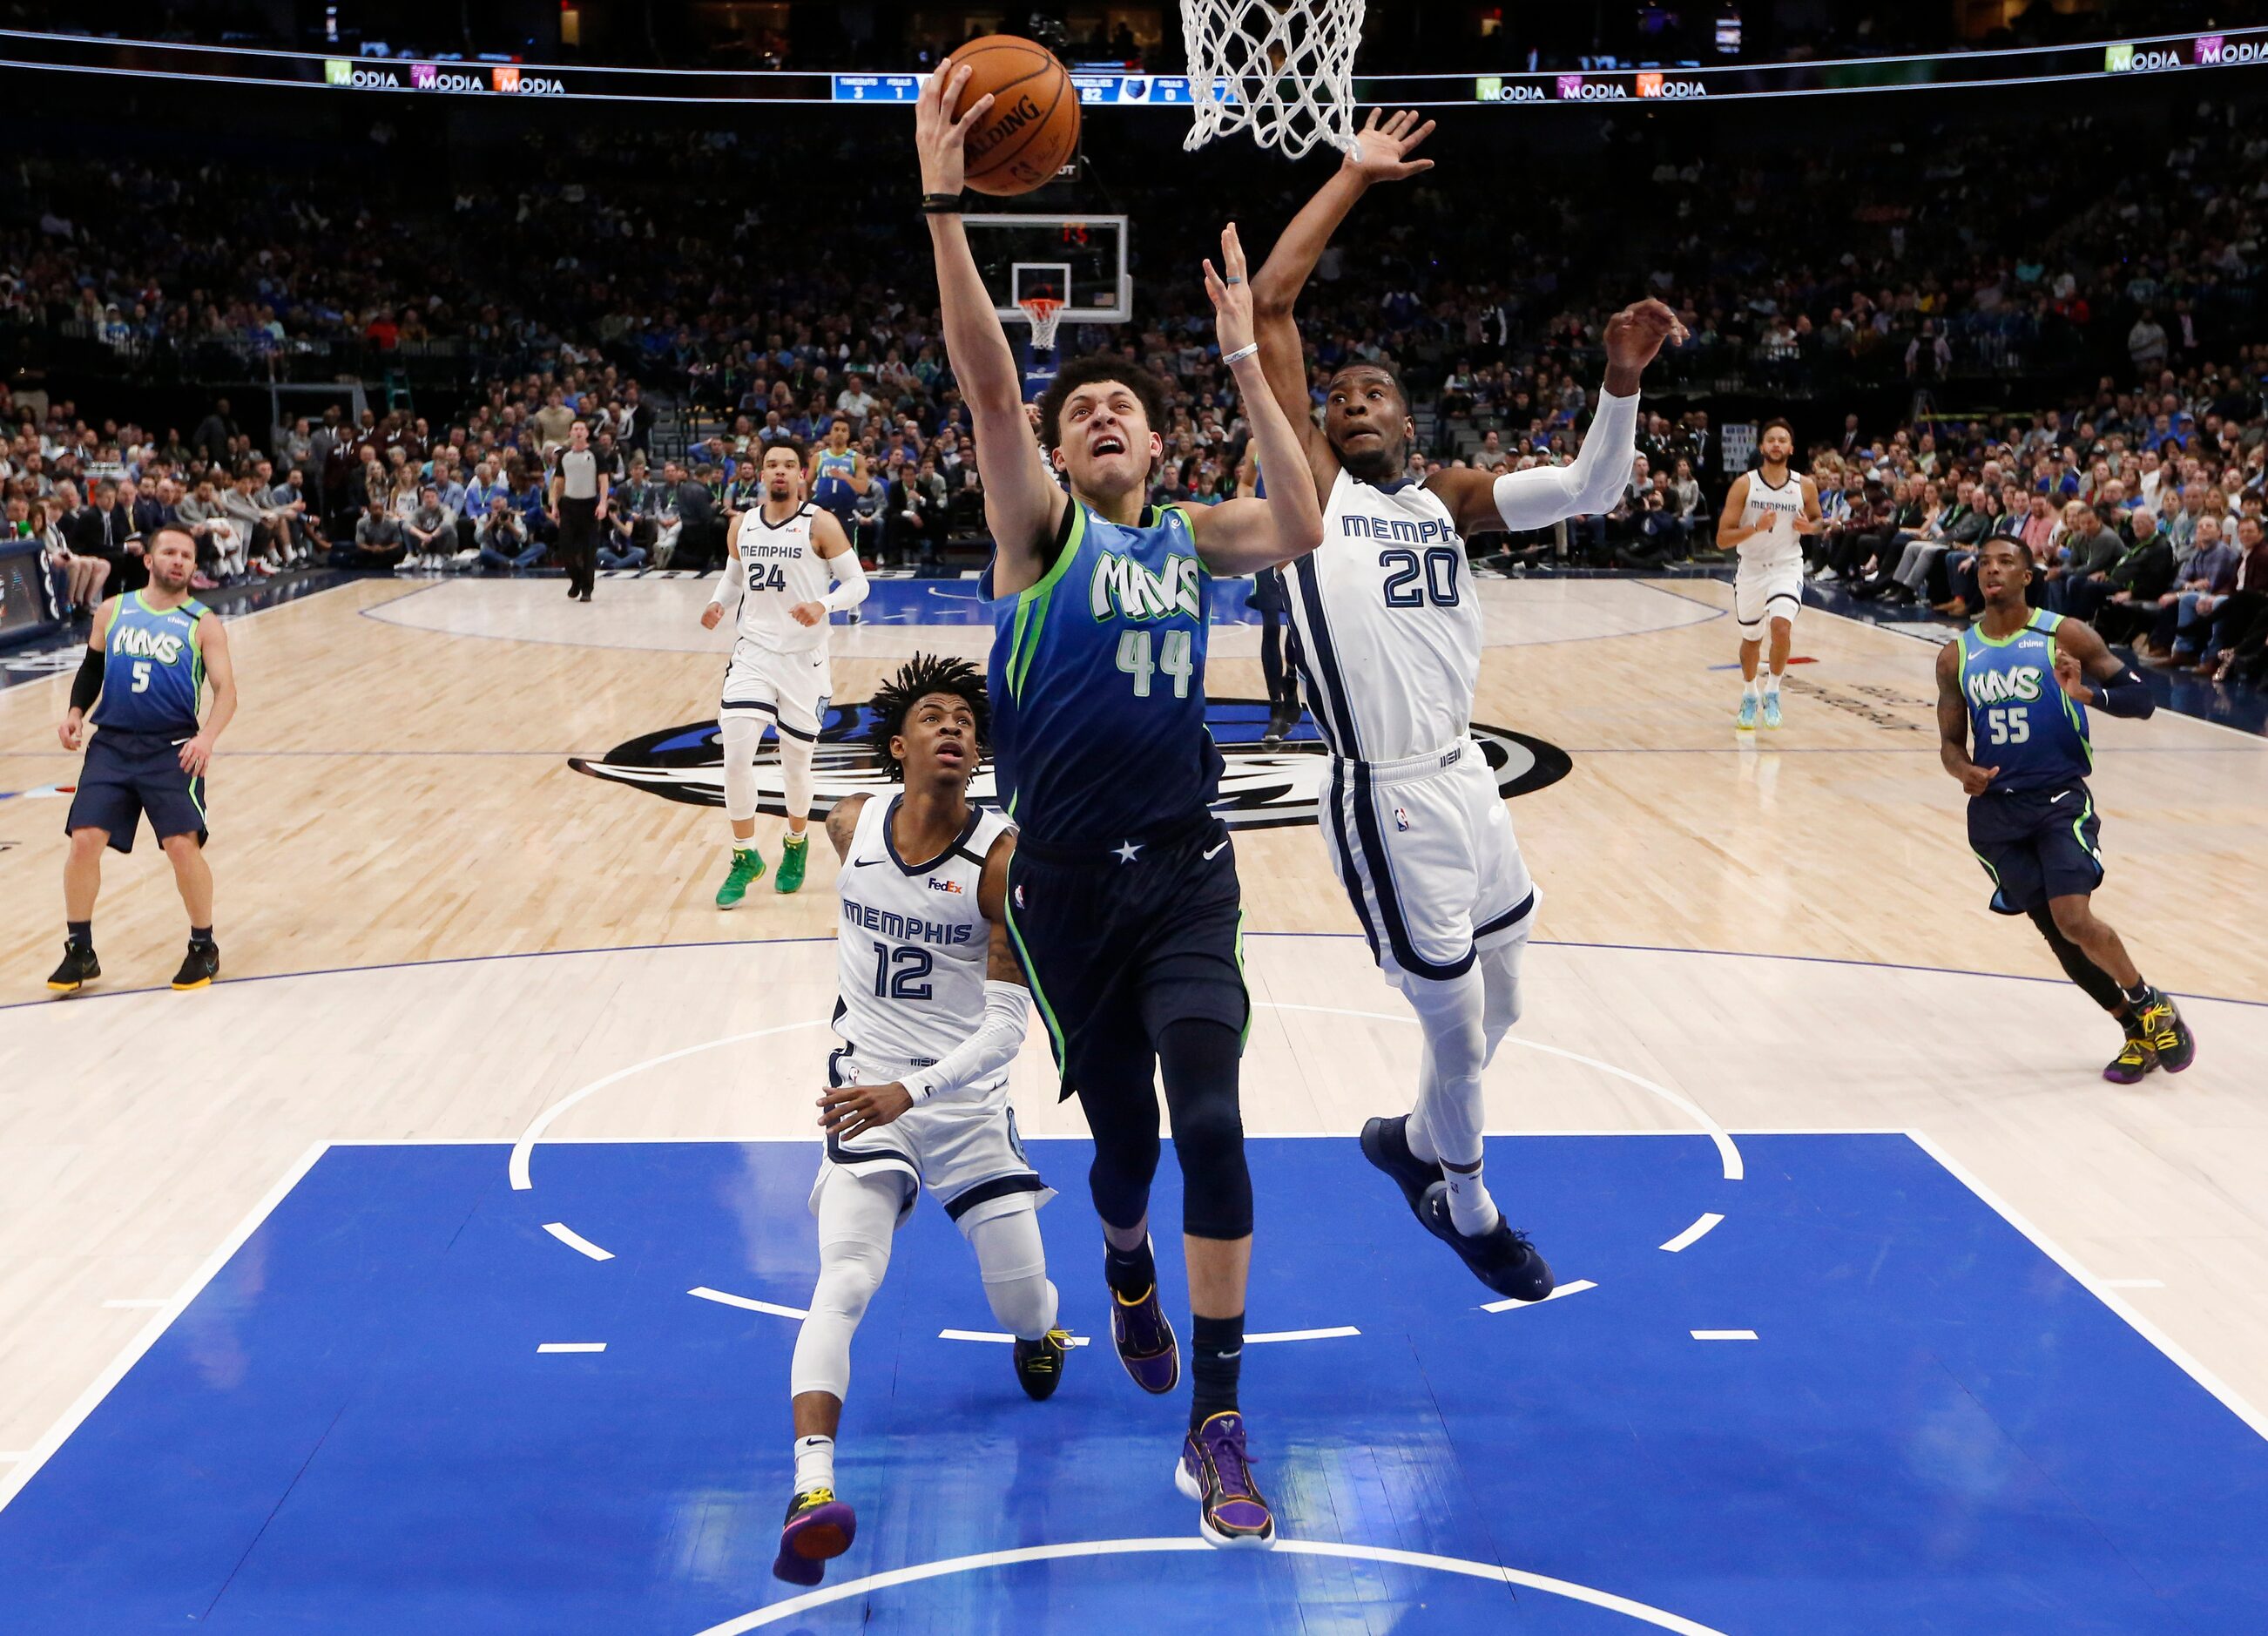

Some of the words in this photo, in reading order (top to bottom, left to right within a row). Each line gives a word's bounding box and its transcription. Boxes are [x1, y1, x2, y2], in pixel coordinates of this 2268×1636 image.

[2113, 50, 2181, 72] MODIA
[333, 70, 399, 88] MODIA
[418, 74, 484, 91] MODIA
[501, 78, 565, 94] MODIA
[854, 87, 864, 99] 3
[894, 87, 903, 99] 1
[1082, 88, 1103, 102] 82
[1164, 89, 1176, 101] 0
[1483, 85, 1546, 101] MODIA
[1563, 84, 1627, 99] MODIA
[1644, 81, 1707, 98] MODIA
[1751, 500, 1797, 513] MEMPHIS
[740, 545, 803, 558] MEMPHIS
[748, 563, 786, 592] 24
[1379, 547, 1460, 608] 20
[1090, 550, 1200, 624] MAVS
[112, 624, 185, 666] MAVS
[2018, 639, 2044, 649] chime
[1116, 629, 1194, 699] 44
[131, 660, 152, 693] 5
[1968, 666, 2043, 710] MAVS
[1988, 706, 2030, 746] 55
[928, 877, 962, 895] FedEx
[843, 898, 973, 945] MEMPHIS
[873, 941, 933, 1001] 12
